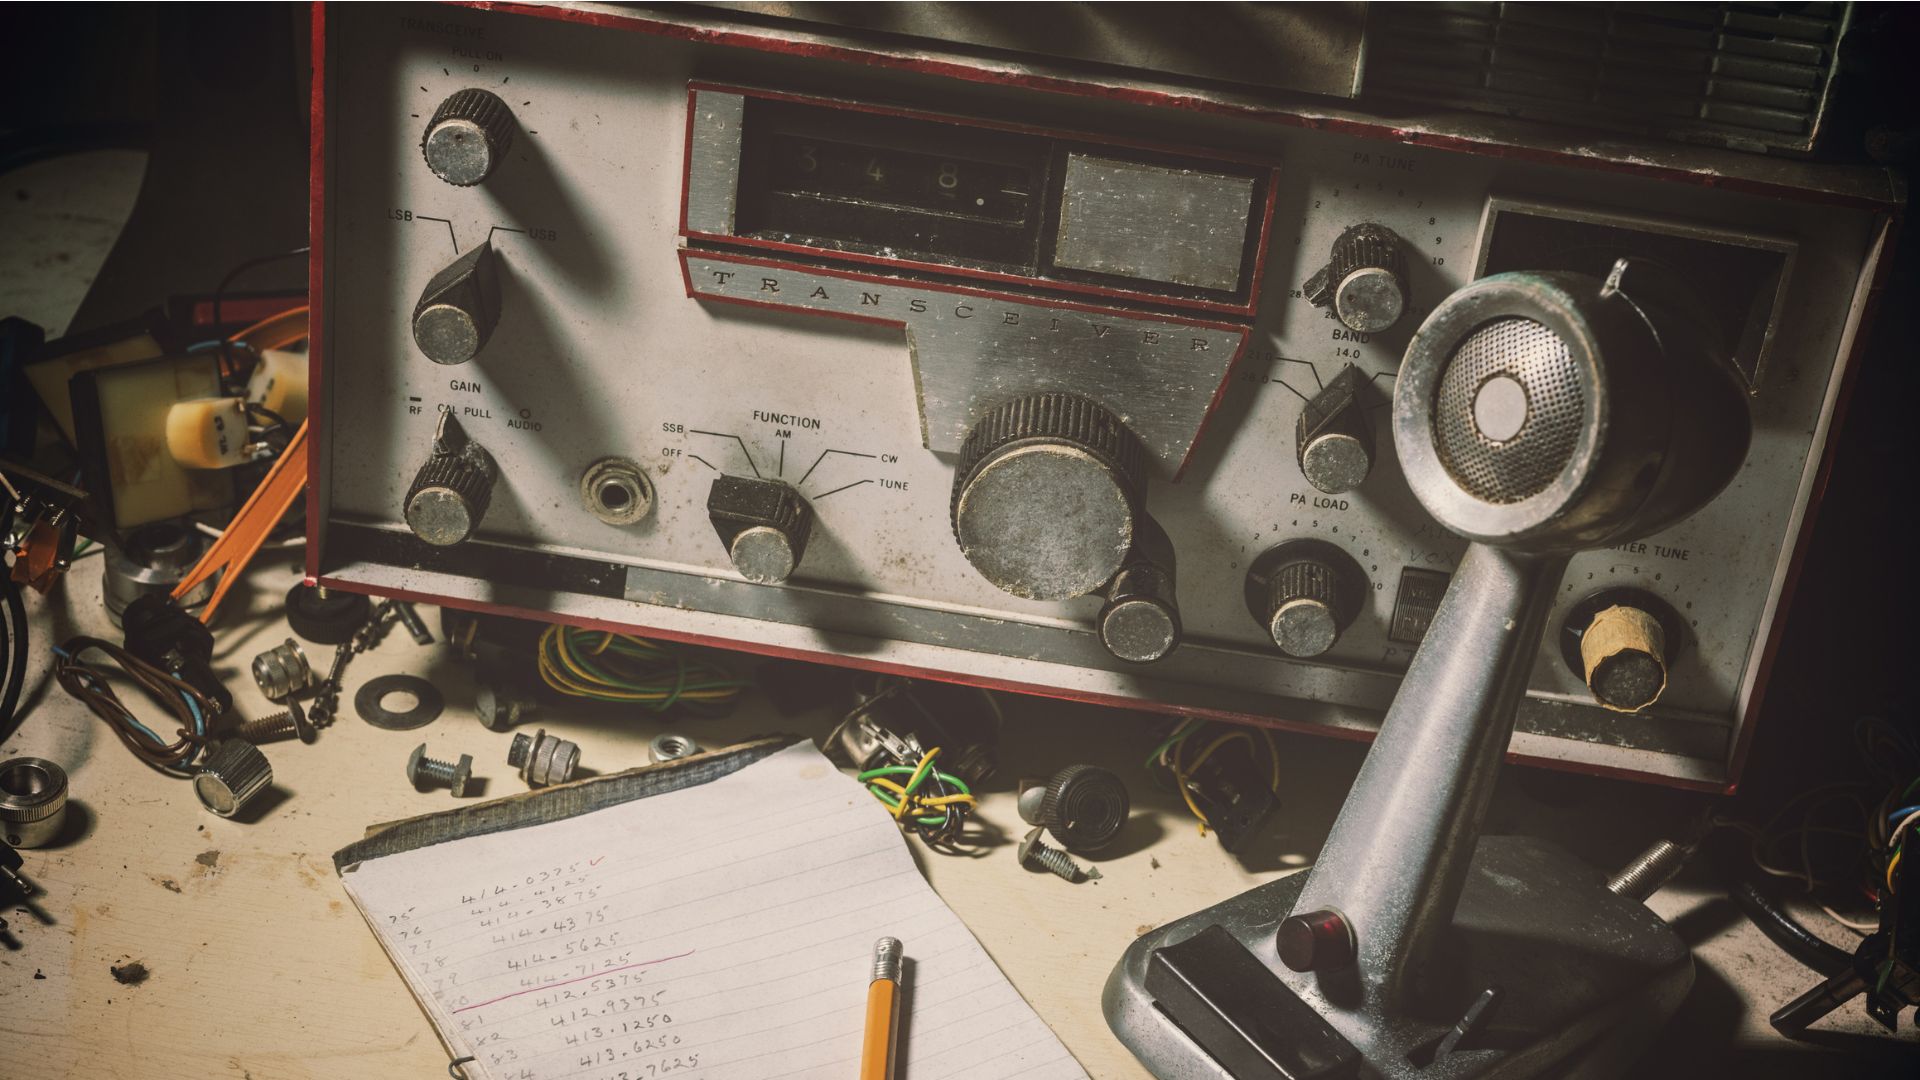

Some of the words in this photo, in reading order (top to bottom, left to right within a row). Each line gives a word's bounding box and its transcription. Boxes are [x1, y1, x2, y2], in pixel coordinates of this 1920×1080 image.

[400, 17, 486, 40] TRANSCEIVE
[451, 46, 482, 60] PULL
[486, 50, 504, 62] ON
[1353, 151, 1370, 165] PA
[1378, 155, 1416, 172] TUNE
[865, 157, 885, 183] 4
[938, 162, 959, 190] 8
[1314, 201, 1321, 209] 2
[388, 209, 413, 222] LSB
[1429, 217, 1436, 226] 8
[529, 228, 557, 242] USB
[1435, 236, 1442, 245] 9
[1433, 257, 1444, 266] 10
[712, 270, 1210, 353] TRANSCEIVER
[1332, 328, 1371, 344] BAND
[1336, 347, 1361, 359] 14.0
[450, 379, 482, 394] GAIN
[409, 405, 423, 416] RF
[464, 406, 493, 419] PULL
[507, 419, 543, 433] AUDIO
[753, 410, 821, 430] FUNCTION
[662, 422, 685, 434] SSB
[775, 428, 792, 440] AM
[662, 447, 683, 459] OFF
[881, 453, 899, 464] CW
[879, 478, 909, 492] TUNE
[1290, 493, 1307, 505] PA
[1313, 494, 1349, 512] LOAD
[1272, 524, 1279, 532] 3
[1292, 519, 1298, 527] 4
[1312, 520, 1318, 528] 5
[1332, 526, 1338, 534] 6
[1253, 533, 1261, 541] 2
[1351, 535, 1357, 543] 7
[1363, 549, 1370, 557] 8
[1654, 545, 1690, 561] TUNE
[1371, 564, 1378, 572] 9
[1609, 566, 1615, 574] 4
[1633, 566, 1640, 574] 5
[1587, 572, 1593, 580] 3
[1655, 572, 1662, 581] 6
[1371, 582, 1383, 591] 10
[1567, 583, 1574, 592] 2
[389, 906, 416, 924] 75
[398, 925, 423, 941] 76
[408, 939, 433, 955] 77
[420, 955, 449, 974] 78
